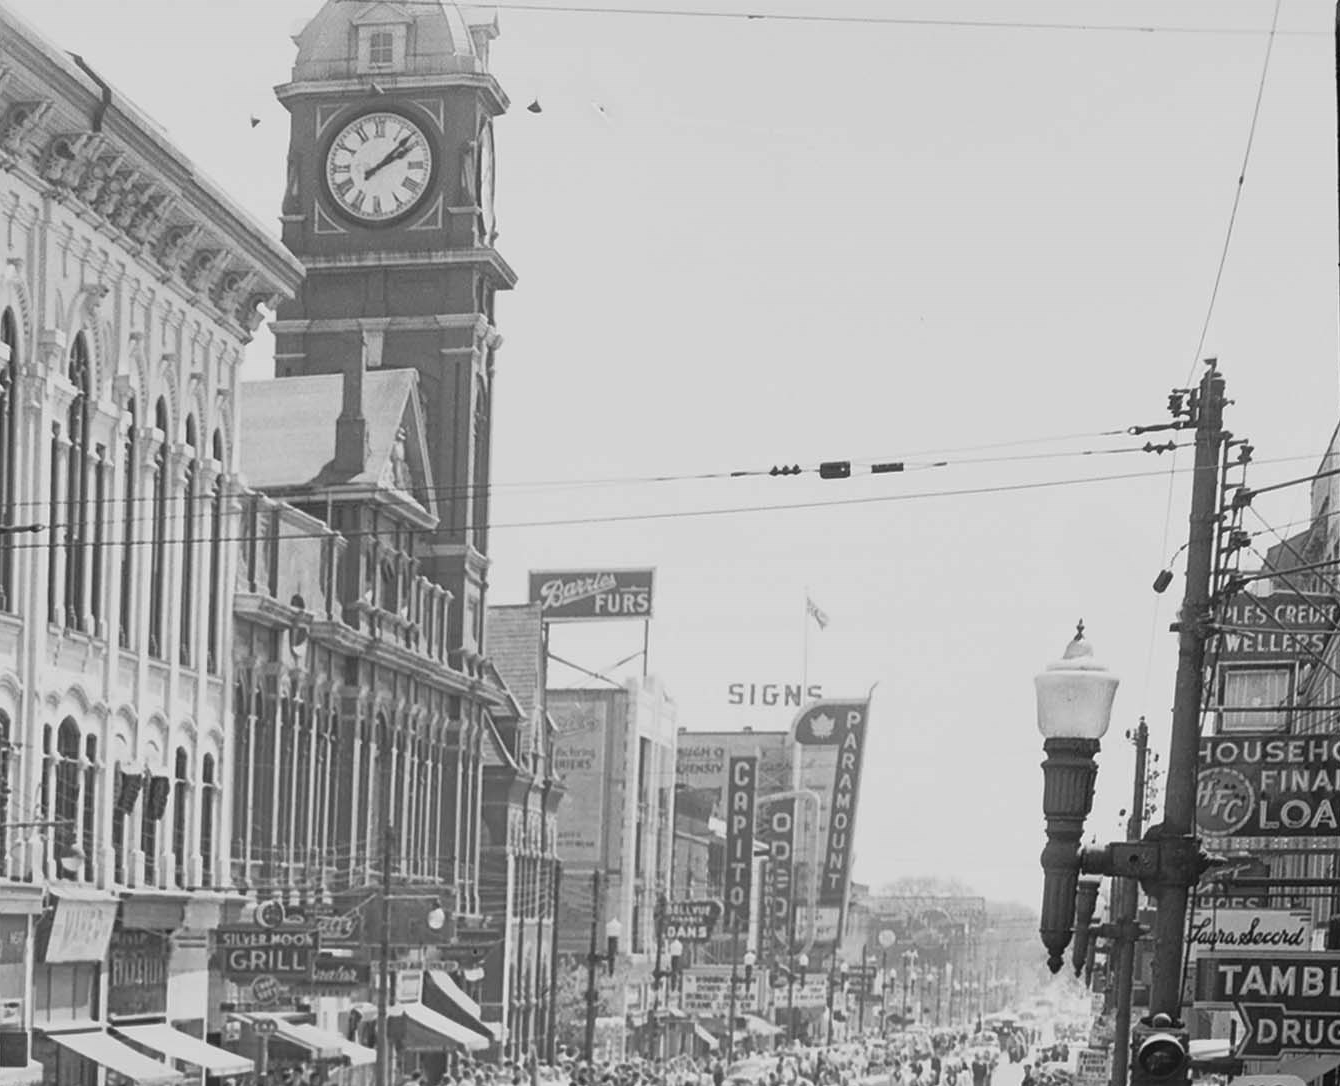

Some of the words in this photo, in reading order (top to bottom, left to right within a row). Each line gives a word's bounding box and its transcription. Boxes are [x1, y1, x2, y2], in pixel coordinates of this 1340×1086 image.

[594, 593, 649, 614] FURS
[1274, 604, 1338, 624] CREDIT
[727, 683, 823, 707] SIGNS
[829, 710, 861, 889] PARAMOUNT
[222, 933, 267, 947] SILVER
[270, 934, 314, 947] MOON
[666, 925, 708, 938] OANS
[1190, 916, 1238, 946] Laura
[1237, 916, 1305, 946] Secord
[229, 950, 307, 972] GRILL
[1218, 965, 1340, 998] TAMBL
[1256, 1018, 1340, 1046] DRUG
